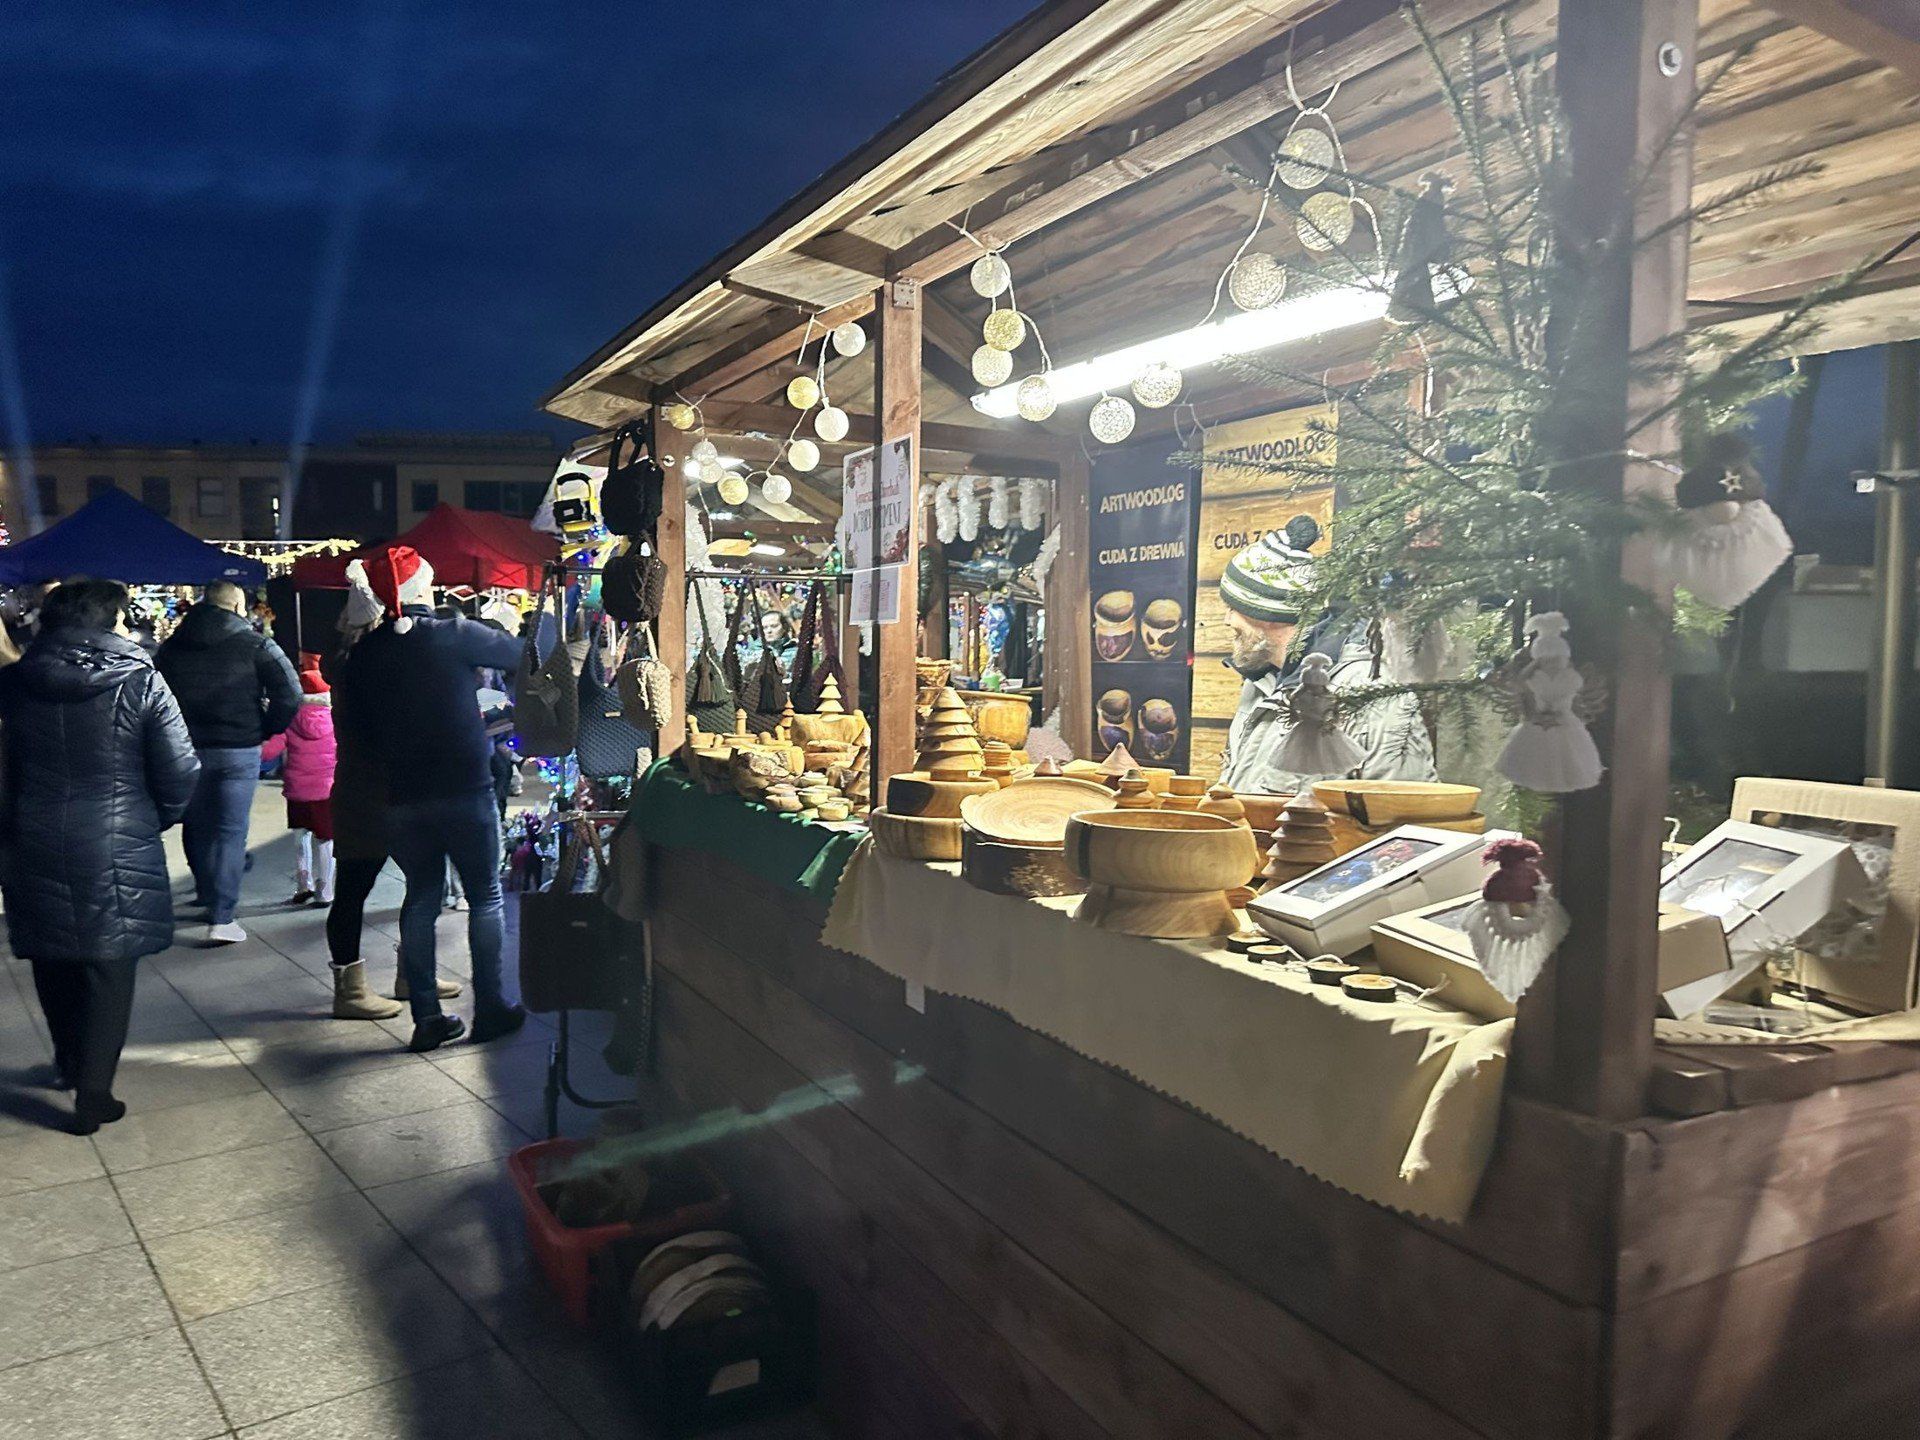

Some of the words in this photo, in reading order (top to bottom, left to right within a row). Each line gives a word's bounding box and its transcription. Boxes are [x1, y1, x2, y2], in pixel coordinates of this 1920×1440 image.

[1100, 483, 1184, 513] ARTWOODLOG
[1214, 531, 1249, 550] CUDA
[1099, 548, 1128, 564] CUDA
[1129, 547, 1138, 562] Z
[1140, 541, 1185, 562] DREWNA
